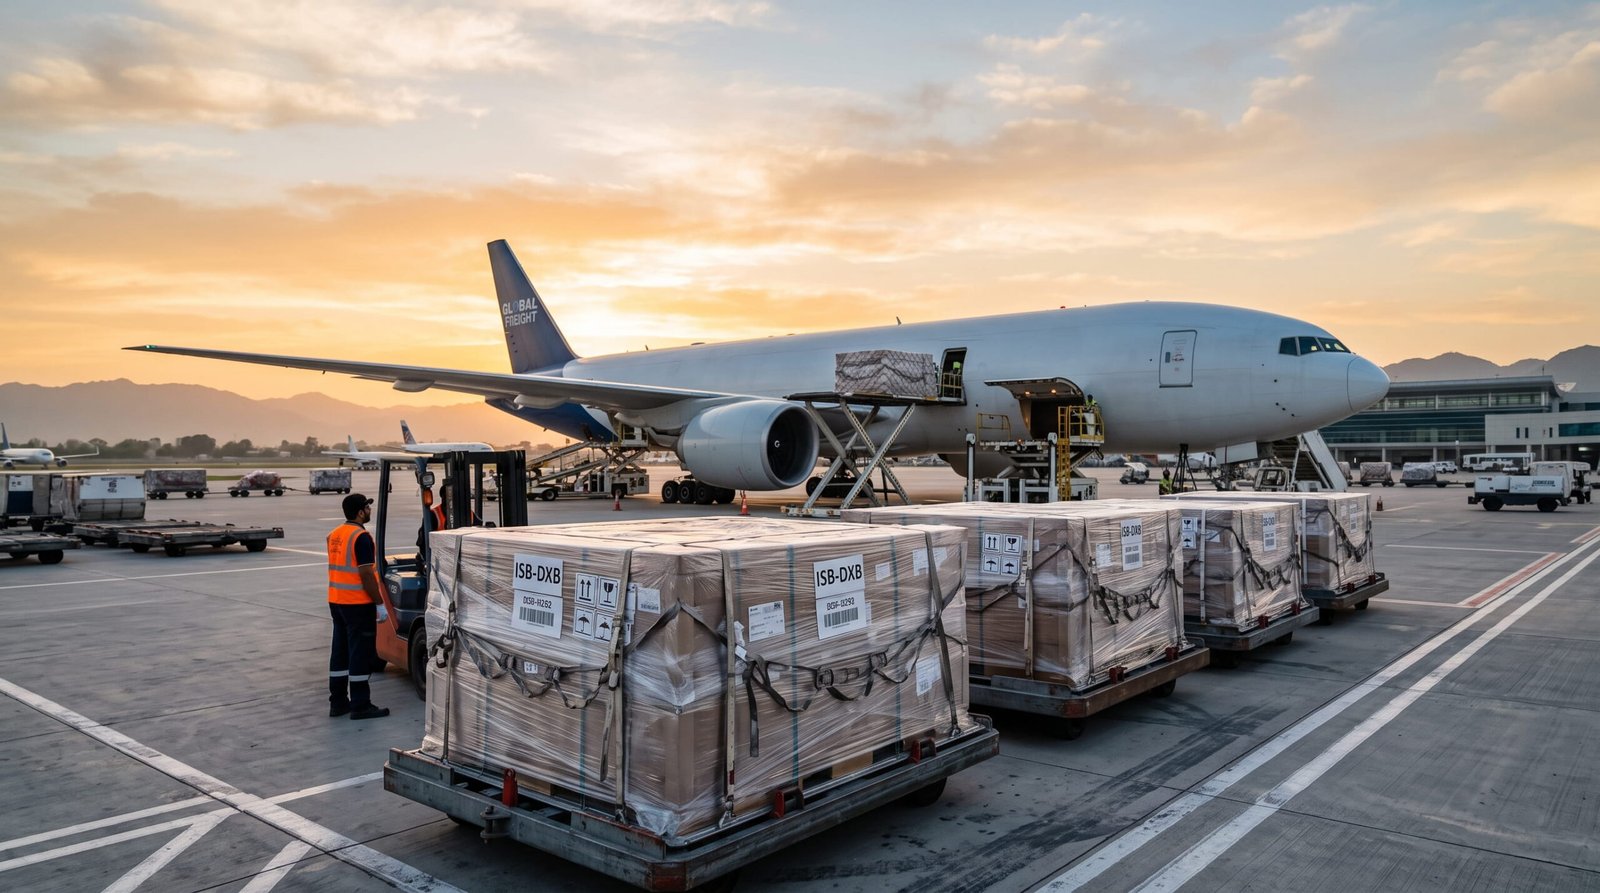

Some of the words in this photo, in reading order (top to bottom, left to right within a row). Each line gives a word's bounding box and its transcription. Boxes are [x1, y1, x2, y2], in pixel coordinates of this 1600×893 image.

[502, 297, 538, 315] GLOBAL
[515, 562, 561, 584] ISB-DXB
[816, 564, 862, 587] ISB-DXB
